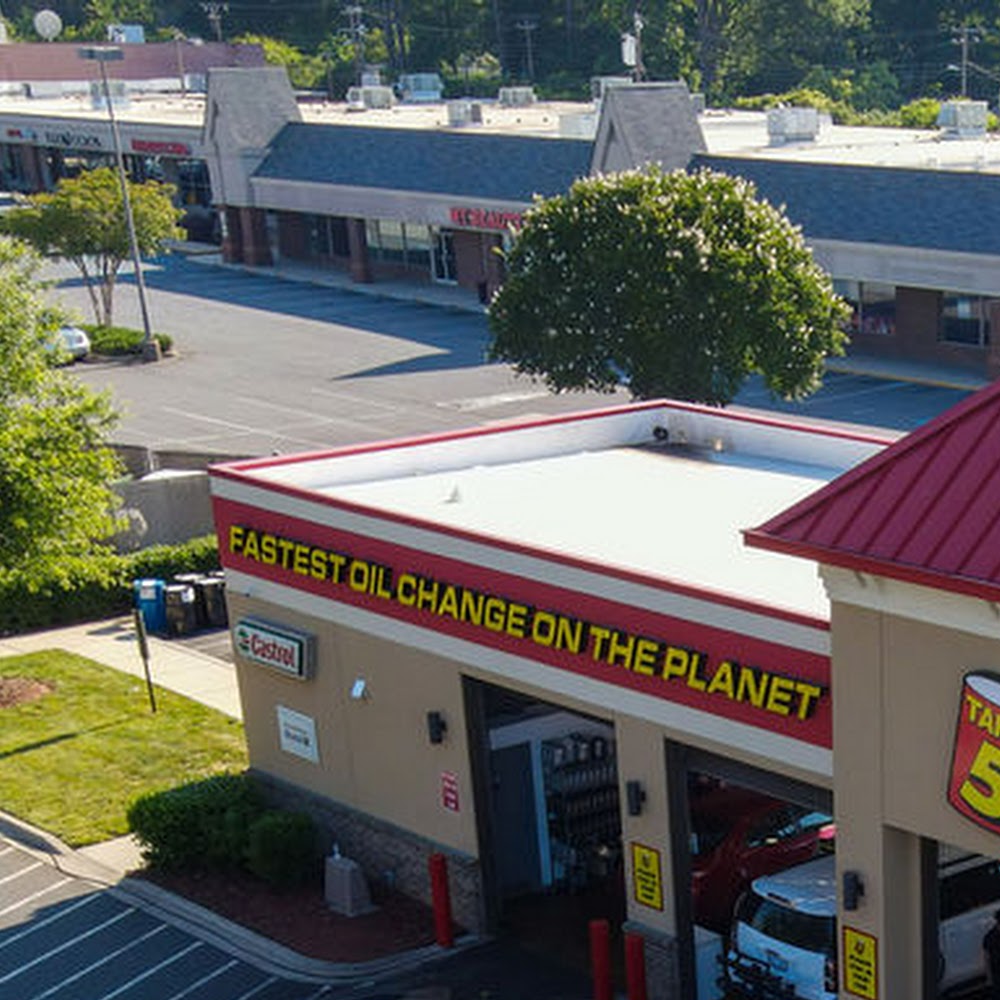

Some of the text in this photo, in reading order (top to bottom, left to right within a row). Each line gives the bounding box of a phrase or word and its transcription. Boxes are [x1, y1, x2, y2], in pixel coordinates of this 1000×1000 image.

[229, 525, 821, 720] FASTEST OIL CHANGE ON THE PLANET
[250, 633, 296, 668] Castrol
